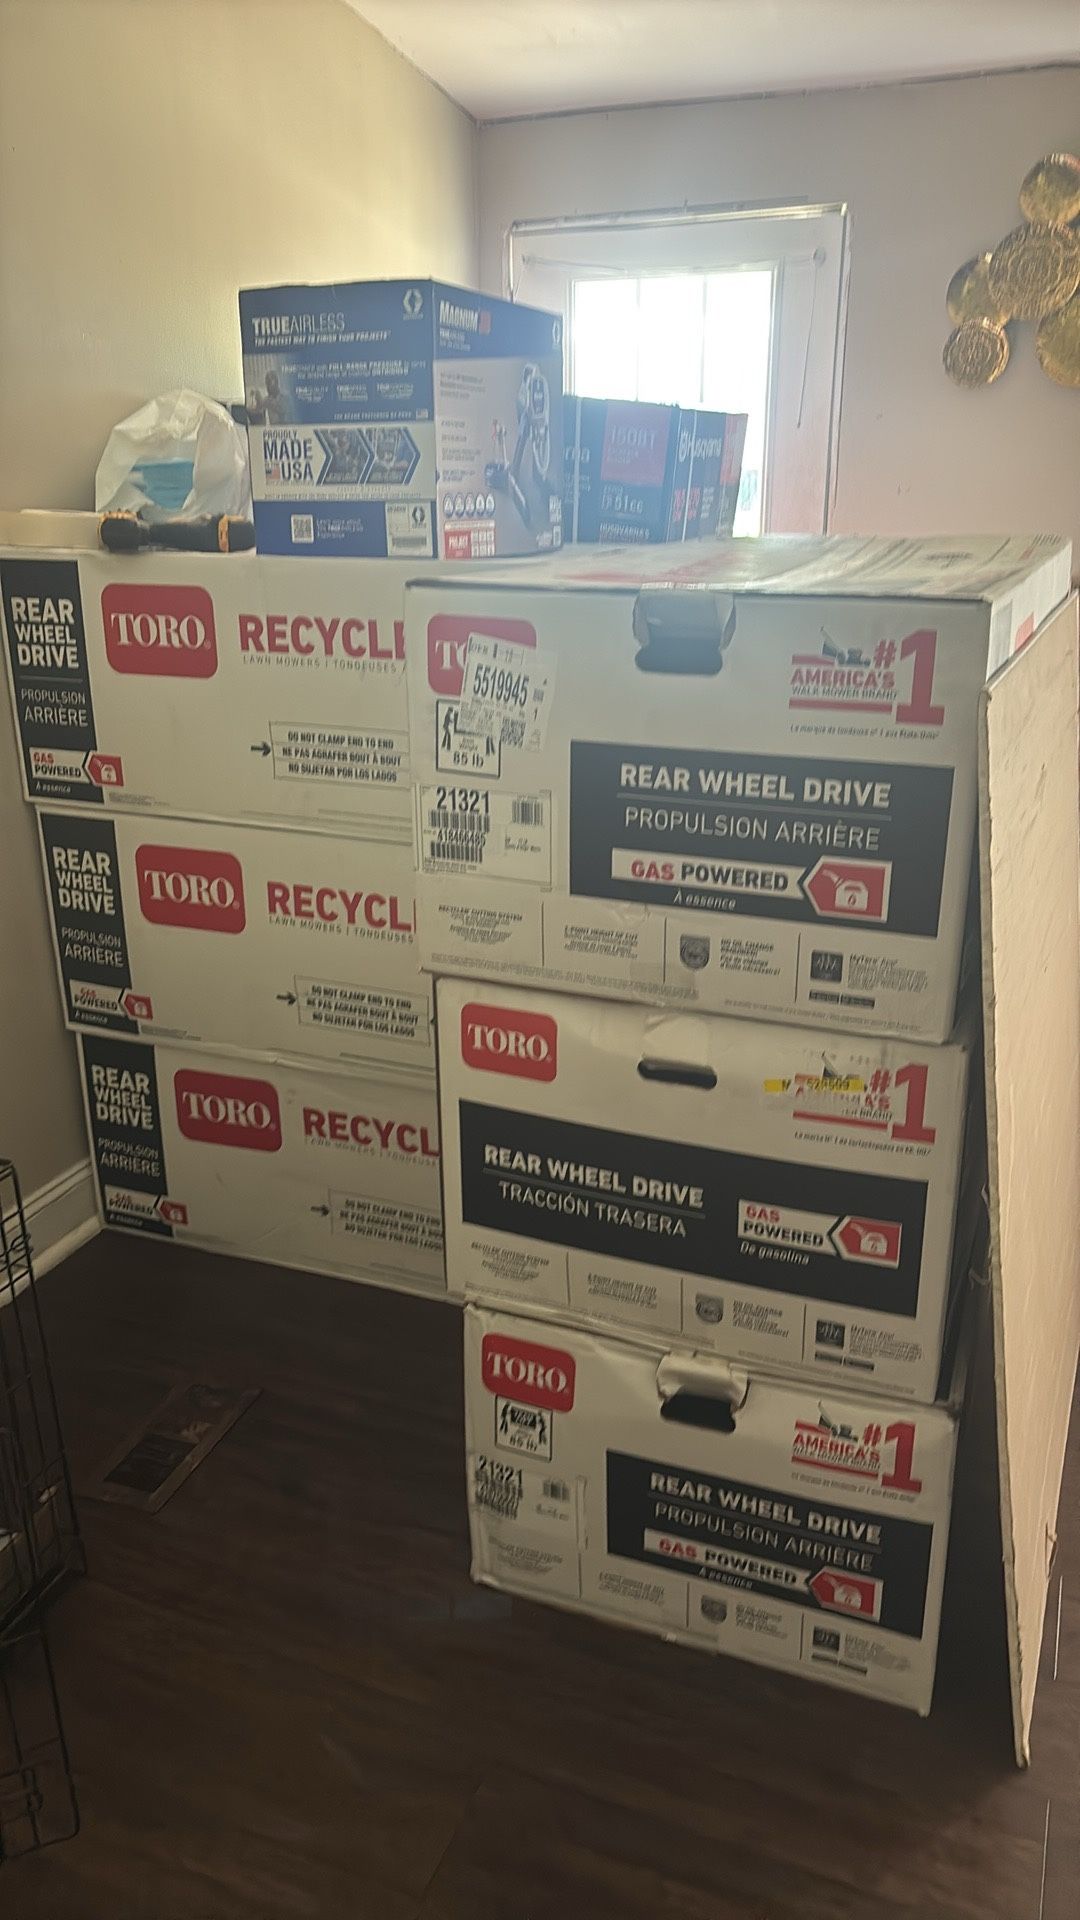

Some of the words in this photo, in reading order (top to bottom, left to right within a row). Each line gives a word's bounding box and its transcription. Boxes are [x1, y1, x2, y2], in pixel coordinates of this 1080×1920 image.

[252, 312, 345, 336] TRUEAIRLESS
[440, 300, 479, 332] MAGNUM
[263, 430, 298, 439] PROUDLY
[263, 439, 313, 460] MADE
[281, 461, 314, 481] USA
[11, 597, 74, 624] REAR
[15, 623, 76, 646] WHEEL
[111, 612, 205, 651] TORO
[17, 644, 80, 669] DRIVE
[243, 655, 271, 665] LAWN
[276, 657, 320, 669] MOWERS
[435, 640, 468, 671] TO
[473, 662, 530, 707] 5519945
[790, 668, 895, 689] AMERICA'S
[20, 688, 87, 706] PROPULSION
[792, 686, 820, 697] WALK
[822, 687, 860, 699] MOWER
[862, 689, 897, 700] BRAND
[24, 703, 89, 728] ARRIÈRE
[288, 731, 299, 742] DO
[300, 732, 316, 744] NOT
[317, 733, 346, 745] CLAMP
[347, 735, 364, 748] END
[365, 737, 376, 749] TO
[377, 738, 394, 750] END
[33, 752, 54, 765] GAS
[294, 747, 310, 759] PAS
[349, 752, 370, 764] BOUT
[34, 764, 82, 778] POWERED
[288, 762, 300, 774] NO
[337, 767, 353, 779] POR
[620, 763, 690, 792] REAR
[698, 768, 795, 801] WHEEL
[803, 777, 892, 809] DRIVE
[436, 785, 489, 814] 21321
[625, 806, 768, 841] PROPULSION
[774, 819, 880, 851] ARRIÈRE
[52, 846, 111, 876] REAR
[55, 870, 114, 896] WHEEL
[145, 870, 234, 908] TORO
[631, 860, 675, 881] GAS
[680, 862, 789, 892] POWERED
[57, 890, 117, 916] DRIVE
[685, 893, 737, 912] essence
[62, 926, 121, 948] PROPULSION
[467, 1023, 549, 1062] TORO
[91, 1064, 150, 1095] REAR
[95, 1088, 152, 1112] WHEEL
[182, 1092, 271, 1131] TORO
[96, 1102, 154, 1132] DRIVE
[484, 1144, 542, 1176] REAR
[547, 1158, 627, 1194] WHEEL
[632, 1175, 704, 1209] DRIVE
[498, 1180, 590, 1218] TRACCIÓN
[594, 1201, 686, 1238] TRASERA
[746, 1204, 780, 1224] GAS
[743, 1220, 824, 1248] POWERED
[740, 1241, 755, 1254] De
[759, 1245, 810, 1266] gasolina
[486, 1351, 568, 1394] TORO
[793, 1432, 880, 1462] AMERICA'S
[651, 1471, 712, 1505] REAR
[718, 1488, 801, 1527] WHEEL
[807, 1510, 882, 1547] DRIVE
[655, 1501, 779, 1549] PROPULSION
[659, 1537, 698, 1559] GAS
[704, 1543, 797, 1586] POWERED
